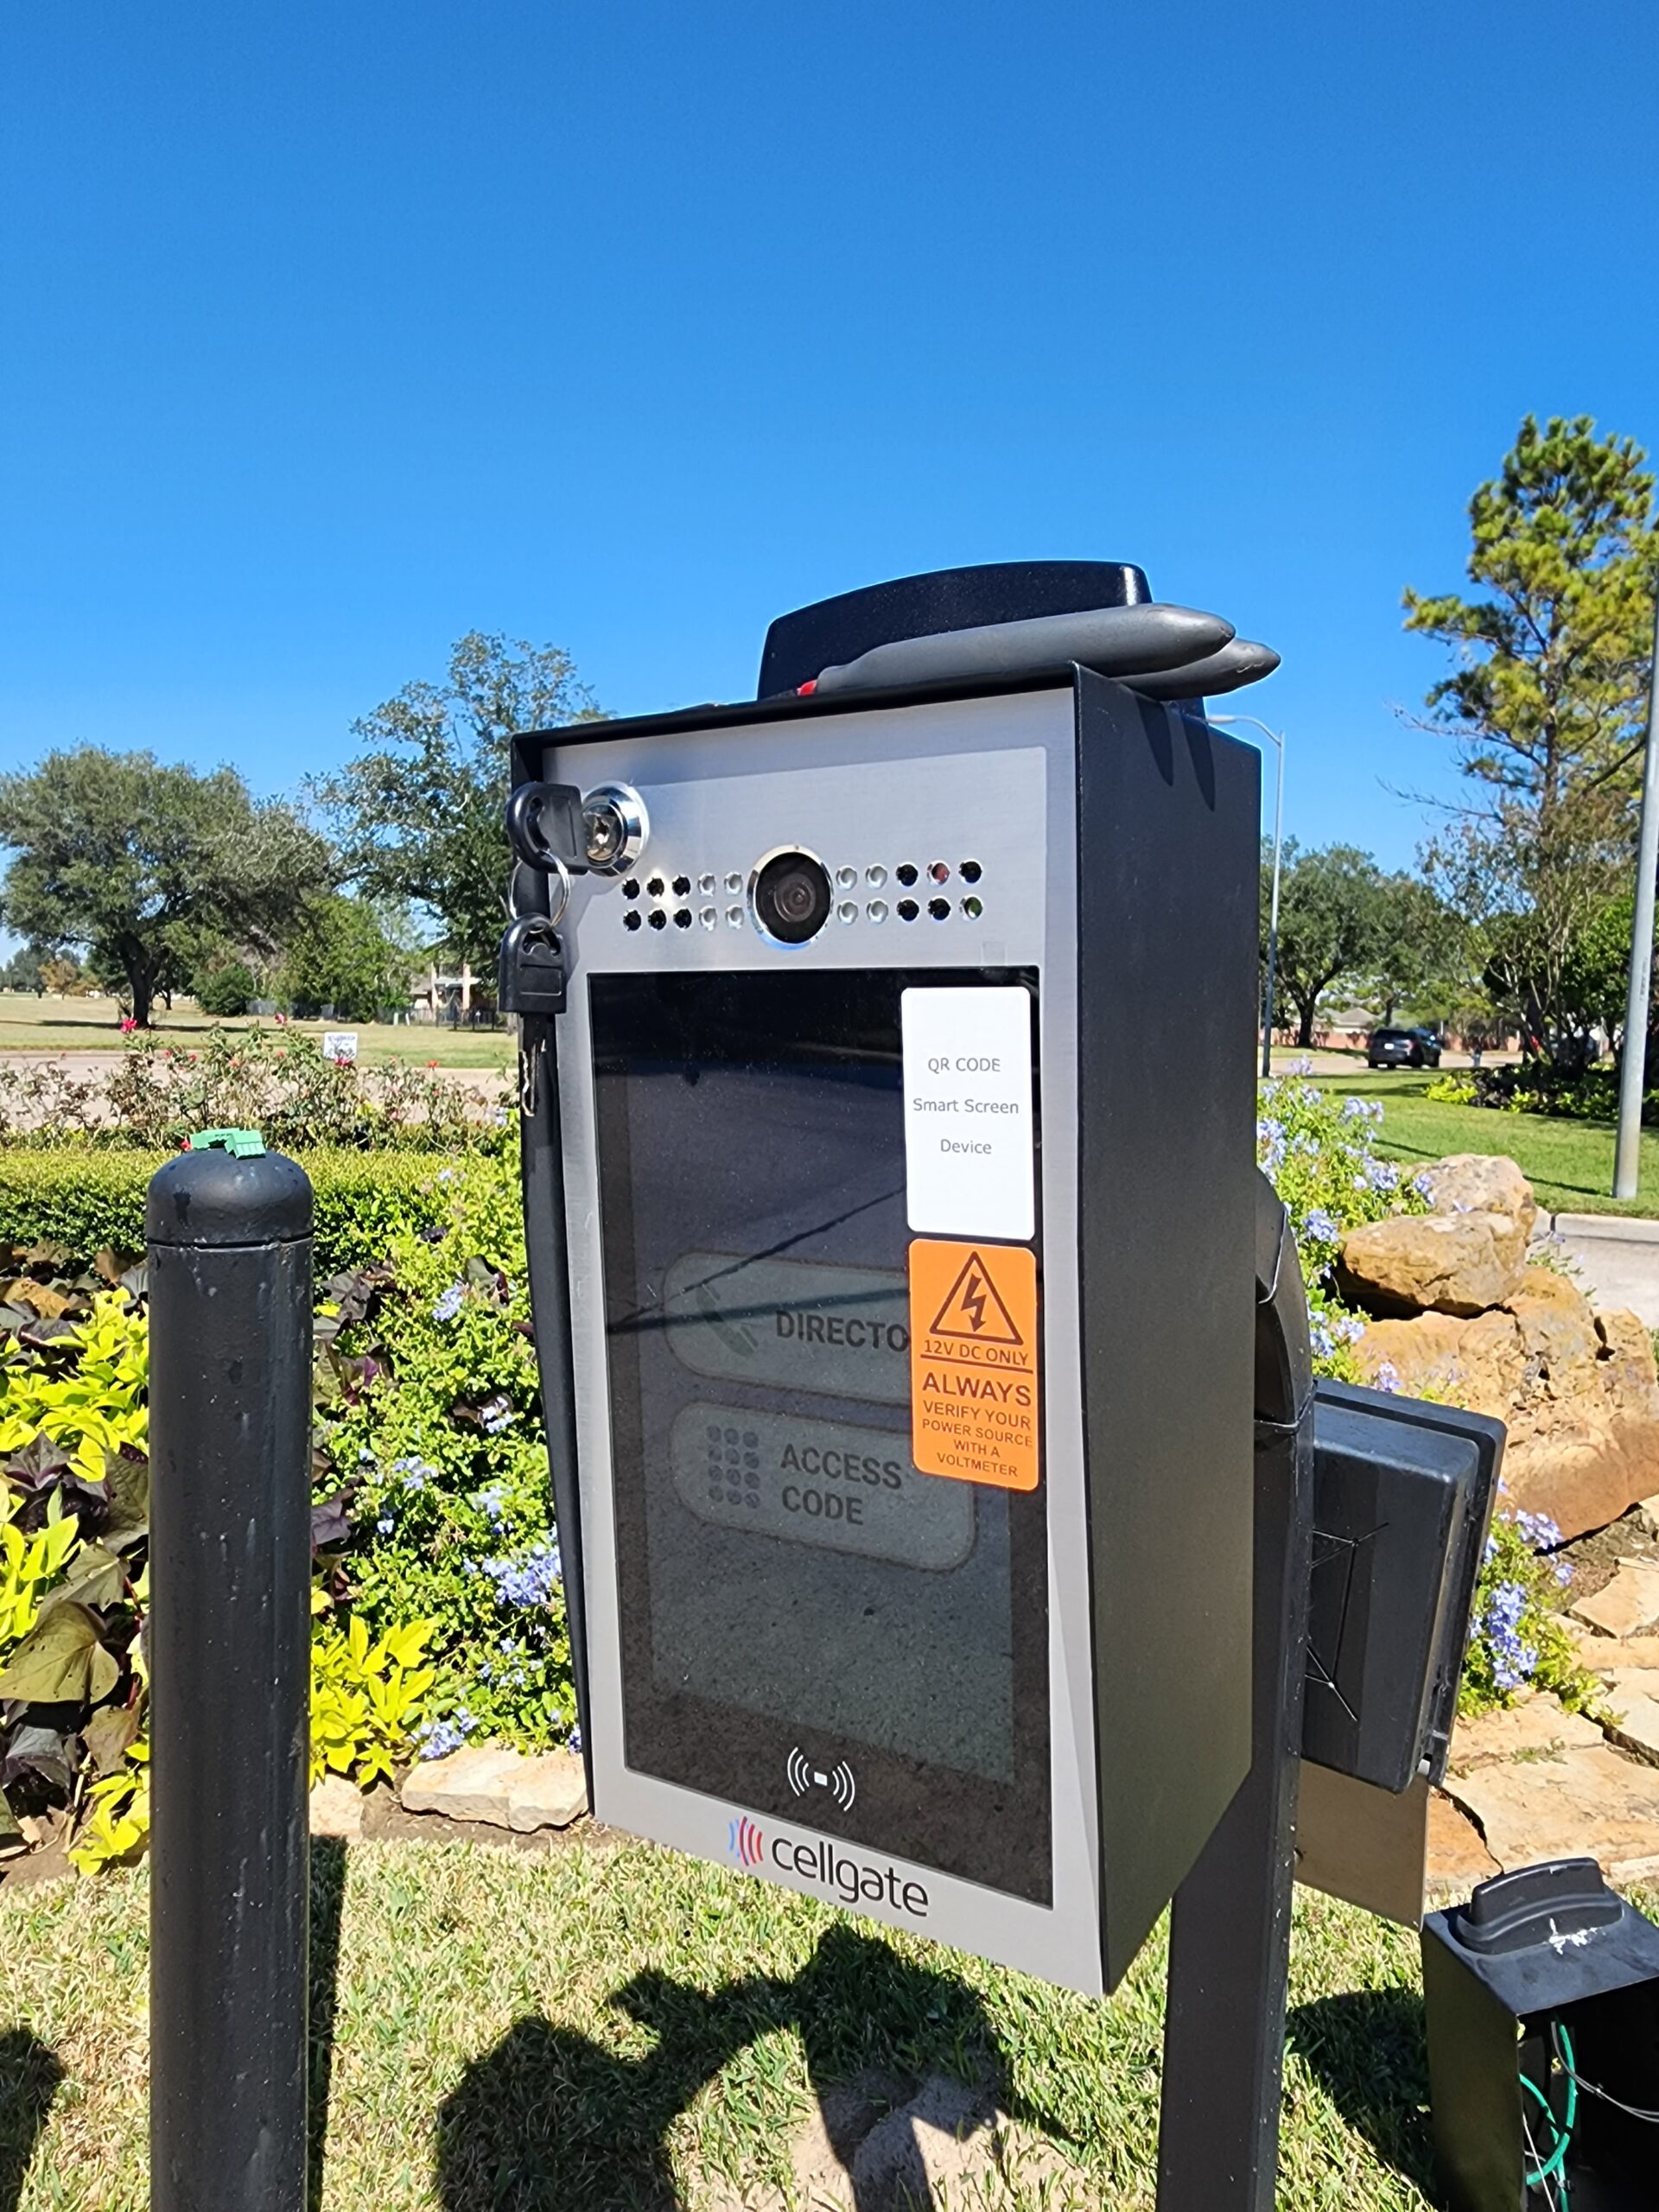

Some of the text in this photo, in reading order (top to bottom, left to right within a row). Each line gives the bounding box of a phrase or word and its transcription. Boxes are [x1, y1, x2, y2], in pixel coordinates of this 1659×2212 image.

[928, 1058, 1001, 1074] QR CODE
[912, 1098, 1019, 1114] Smart Screen
[940, 1139, 992, 1154] Device
[776, 1311, 909, 1353] DIRECTO
[925, 1340, 1028, 1366] 12V DC ONLY
[923, 1372, 1031, 1407] ALWAYS
[923, 1400, 1031, 1430] VERIFY YOUR
[922, 1419, 1033, 1447] POWER SOURCE
[953, 1440, 1001, 1458] WITH A
[781, 1444, 902, 1490] ACCESS
[937, 1452, 1018, 1477] VOLTMETER
[782, 1486, 864, 1525] CODE
[772, 1838, 929, 1917] cellgate
